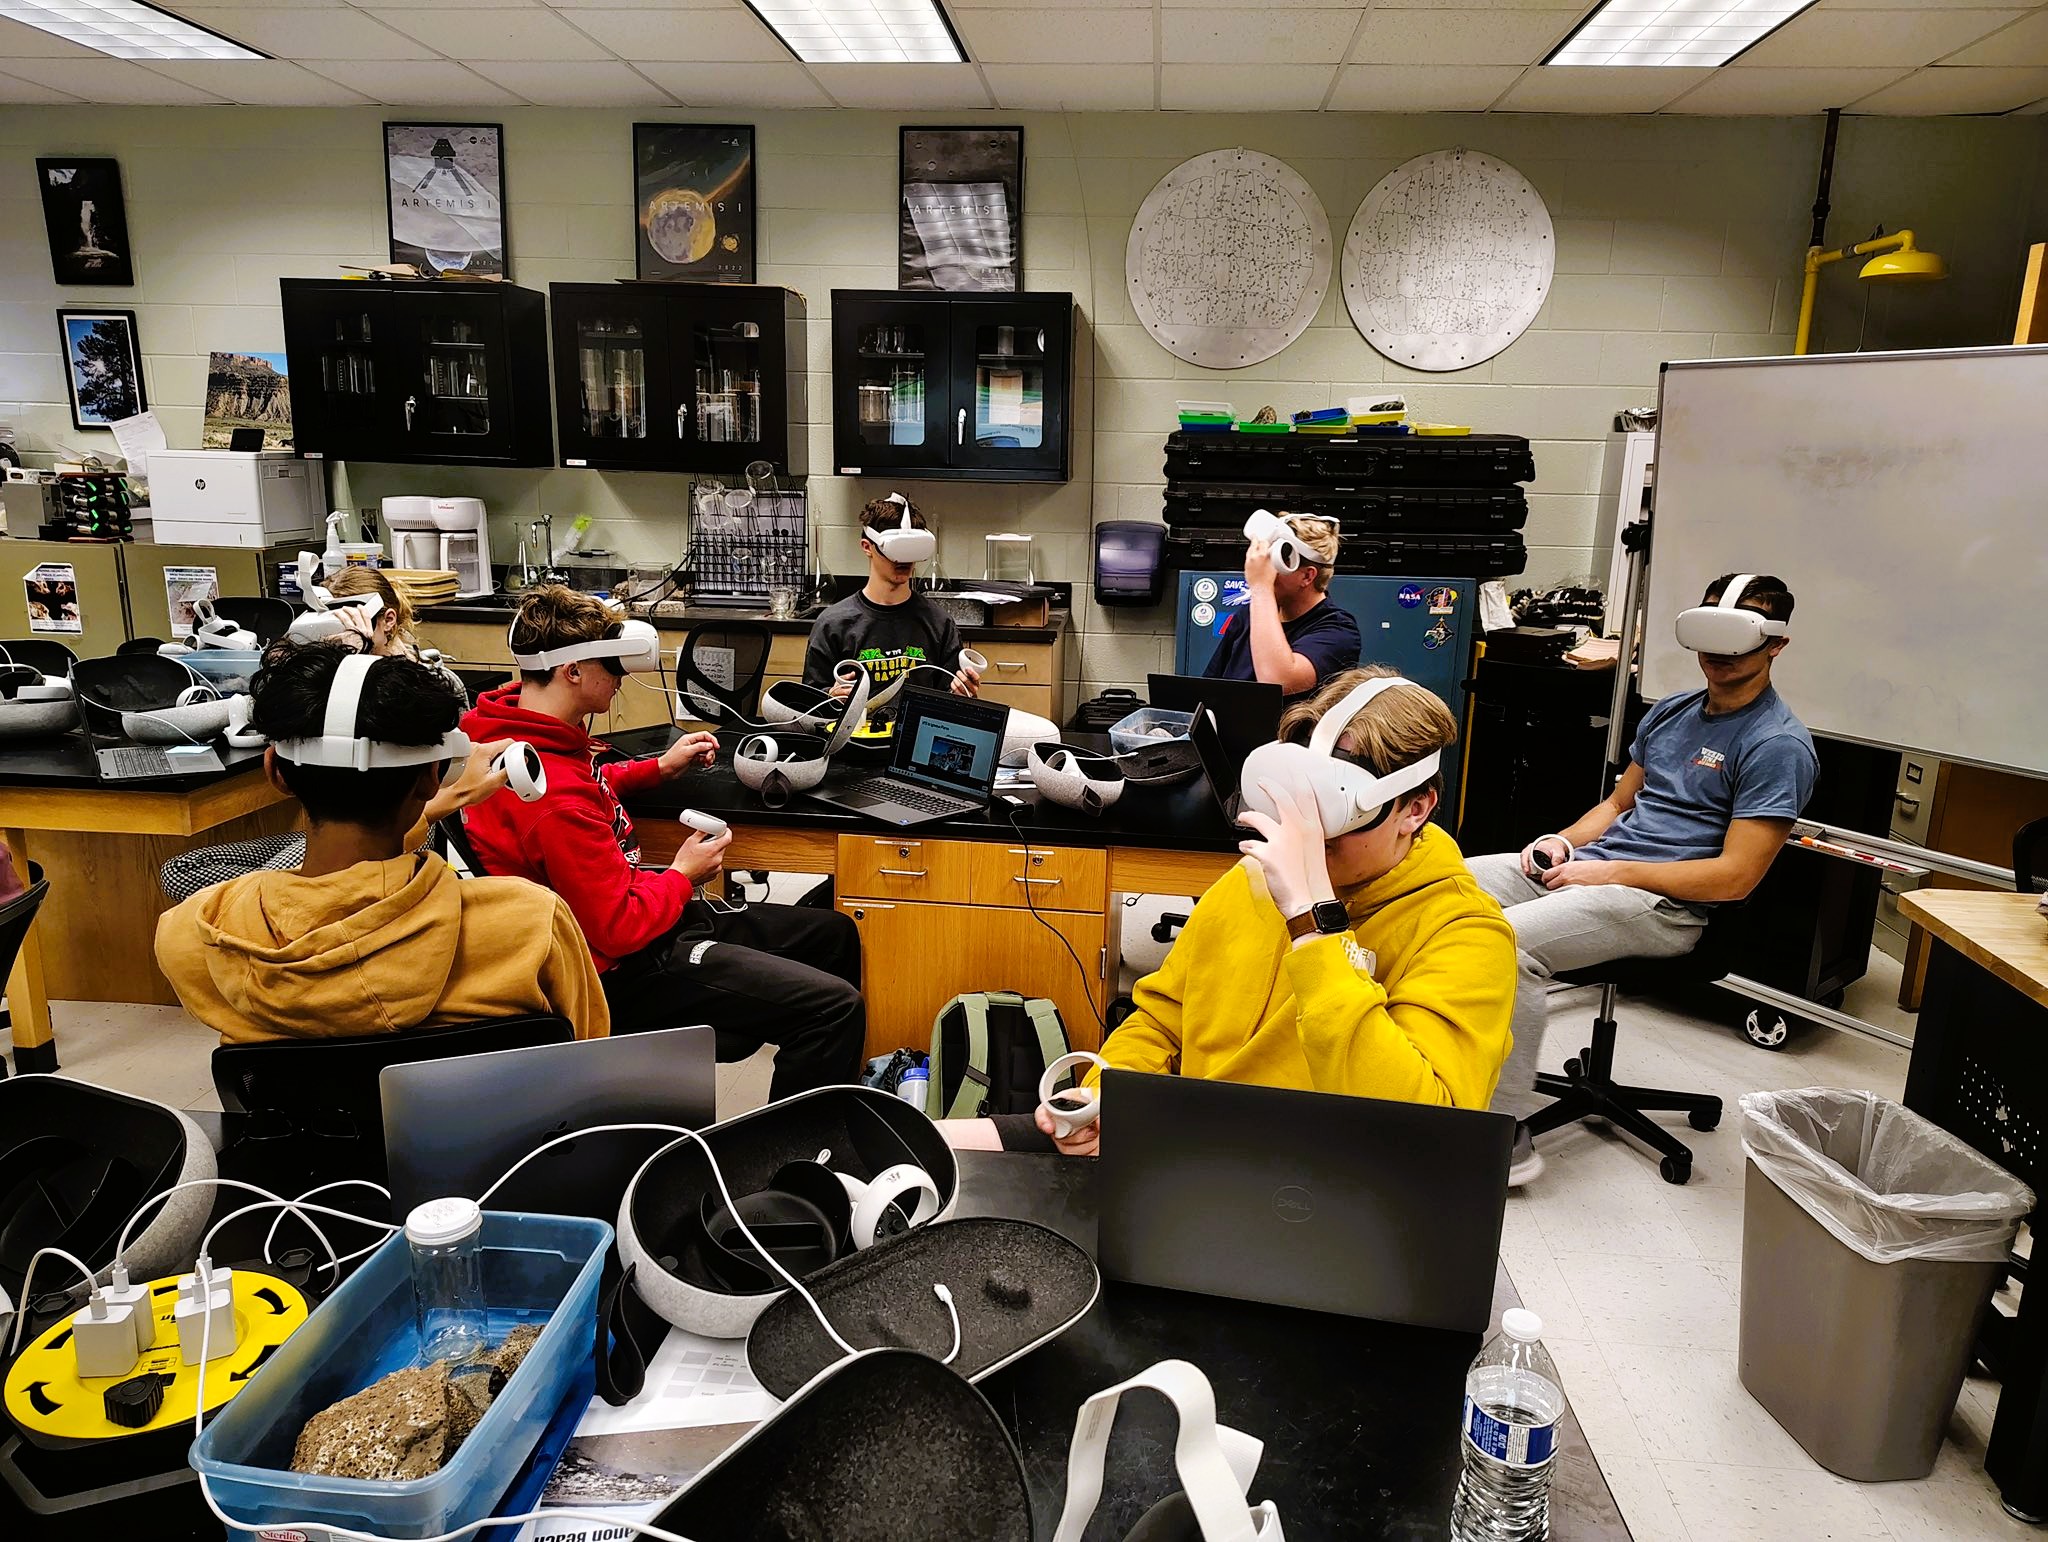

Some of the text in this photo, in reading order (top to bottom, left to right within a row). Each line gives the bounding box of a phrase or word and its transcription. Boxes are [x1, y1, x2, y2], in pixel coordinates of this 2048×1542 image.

[402, 199, 474, 208] ARTEMIS
[649, 201, 725, 212] ARTEMIS
[914, 205, 990, 215] ARTEMIS
[1224, 580, 1245, 589] SAVE
[1399, 592, 1421, 600] NASA
[264, 1531, 302, 1541] Sterilite
[592, 1526, 634, 1541] anon
